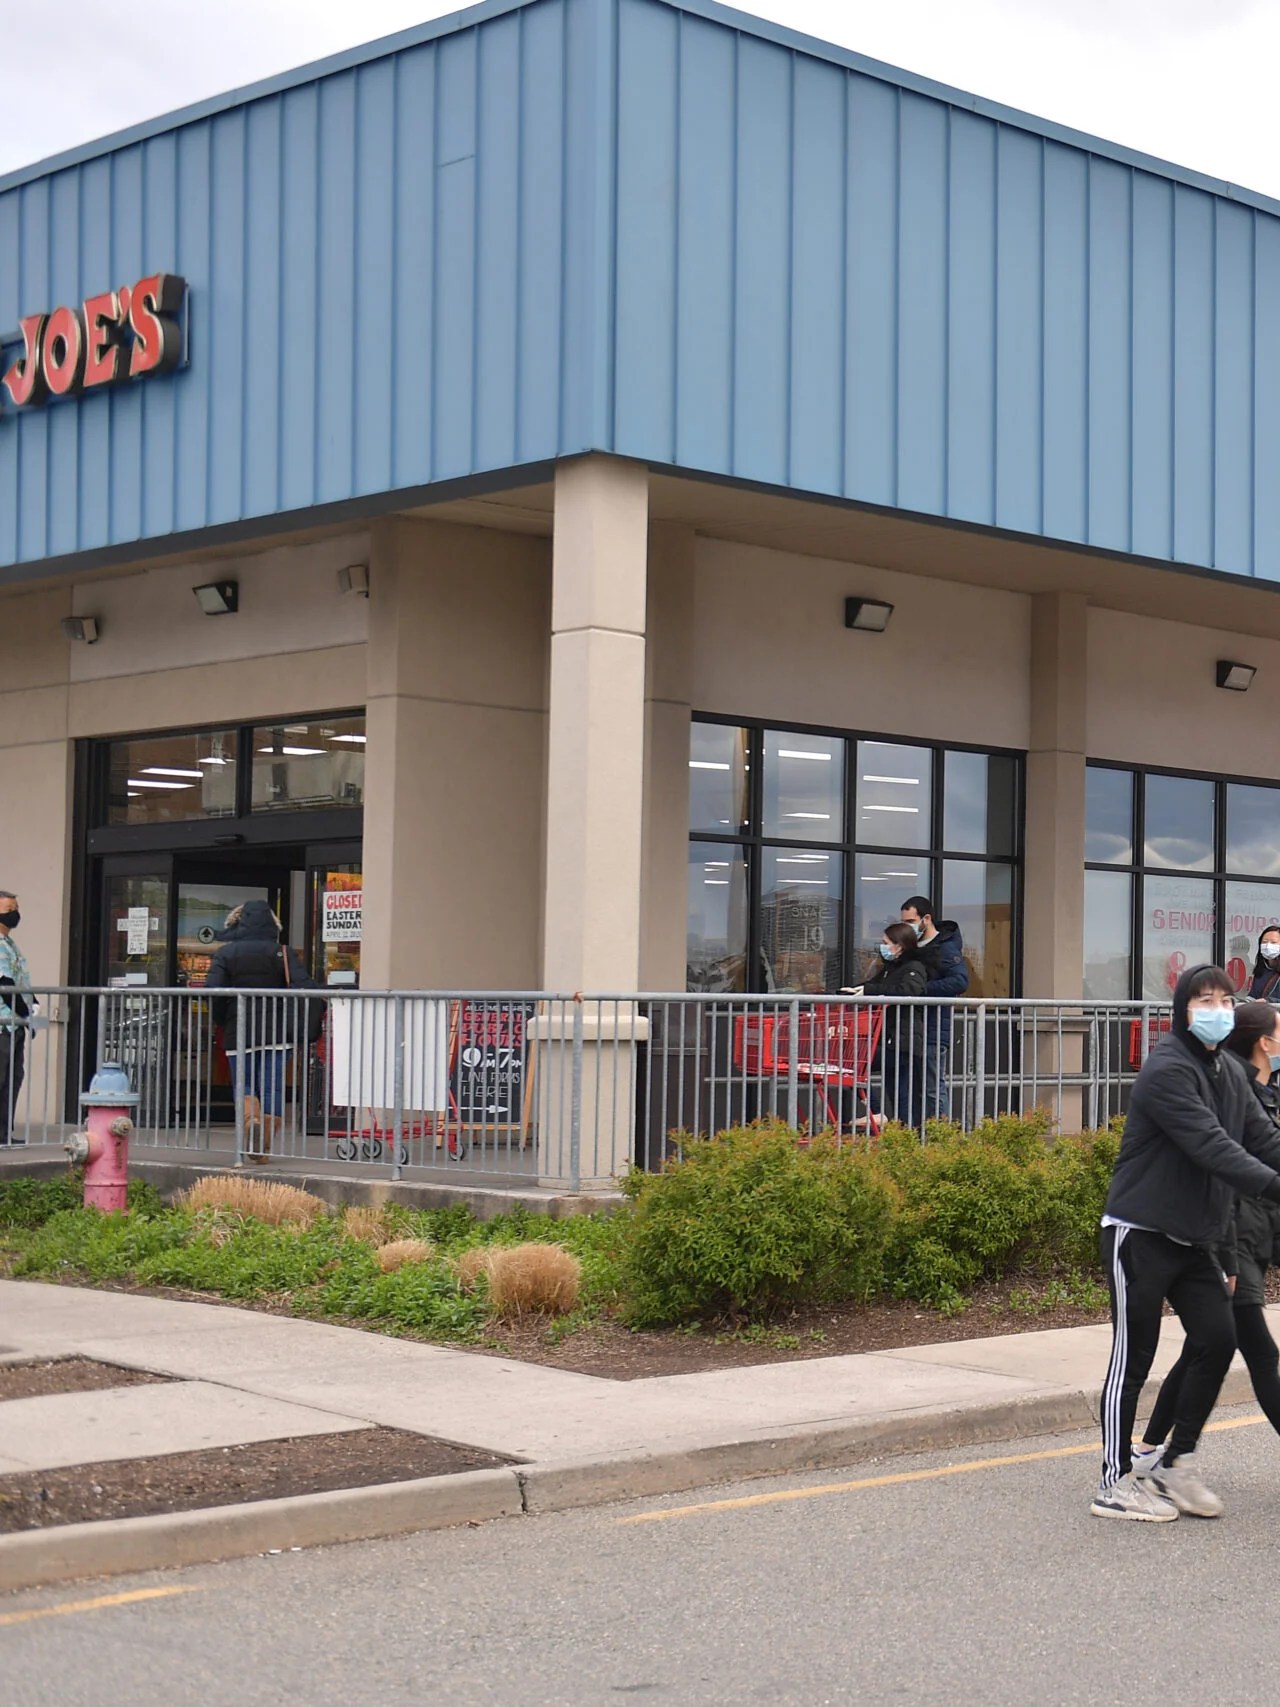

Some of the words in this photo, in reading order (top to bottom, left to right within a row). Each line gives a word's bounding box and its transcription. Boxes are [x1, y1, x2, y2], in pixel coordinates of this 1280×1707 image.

[2, 272, 166, 406] JOE'S
[1152, 908, 1216, 932] SENIOR
[463, 1023, 522, 1033] PUBLC
